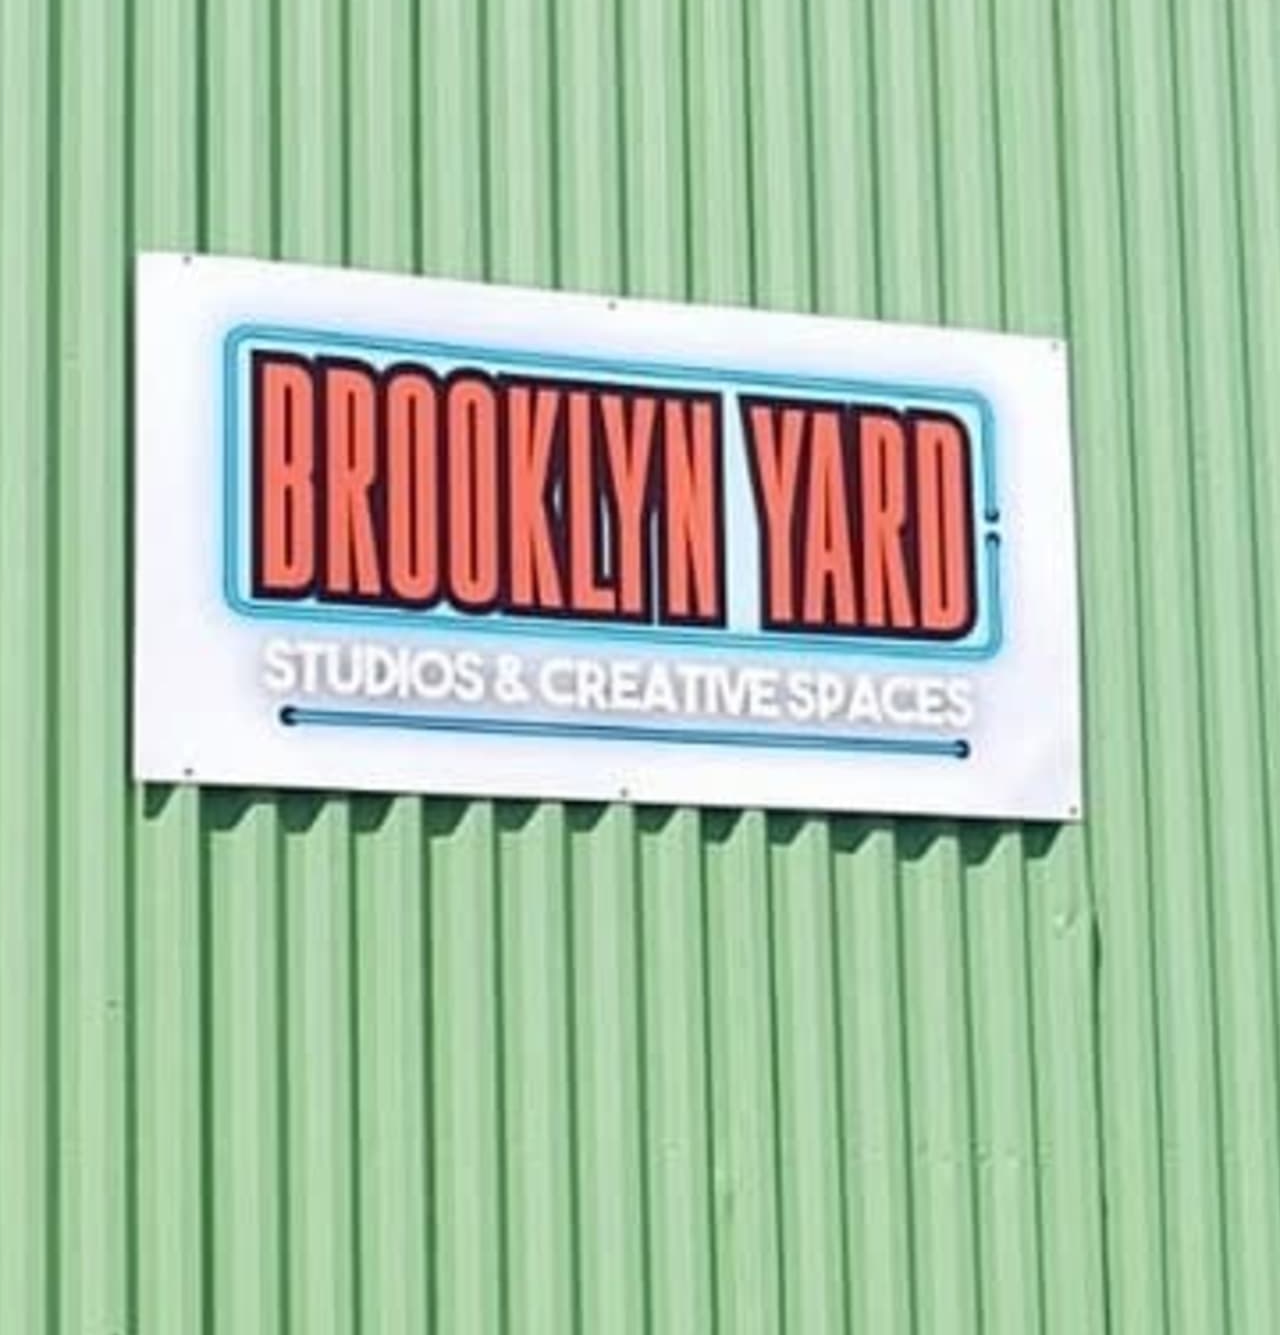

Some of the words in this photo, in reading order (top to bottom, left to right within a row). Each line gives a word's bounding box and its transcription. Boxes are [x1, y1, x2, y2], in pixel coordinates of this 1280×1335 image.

[252, 351, 725, 627] BROOKLYN
[738, 395, 978, 640] YARD
[265, 639, 486, 702] STUDIOS
[494, 653, 530, 703] &
[539, 659, 780, 717] CREATIVE
[787, 671, 975, 727] SPACES
